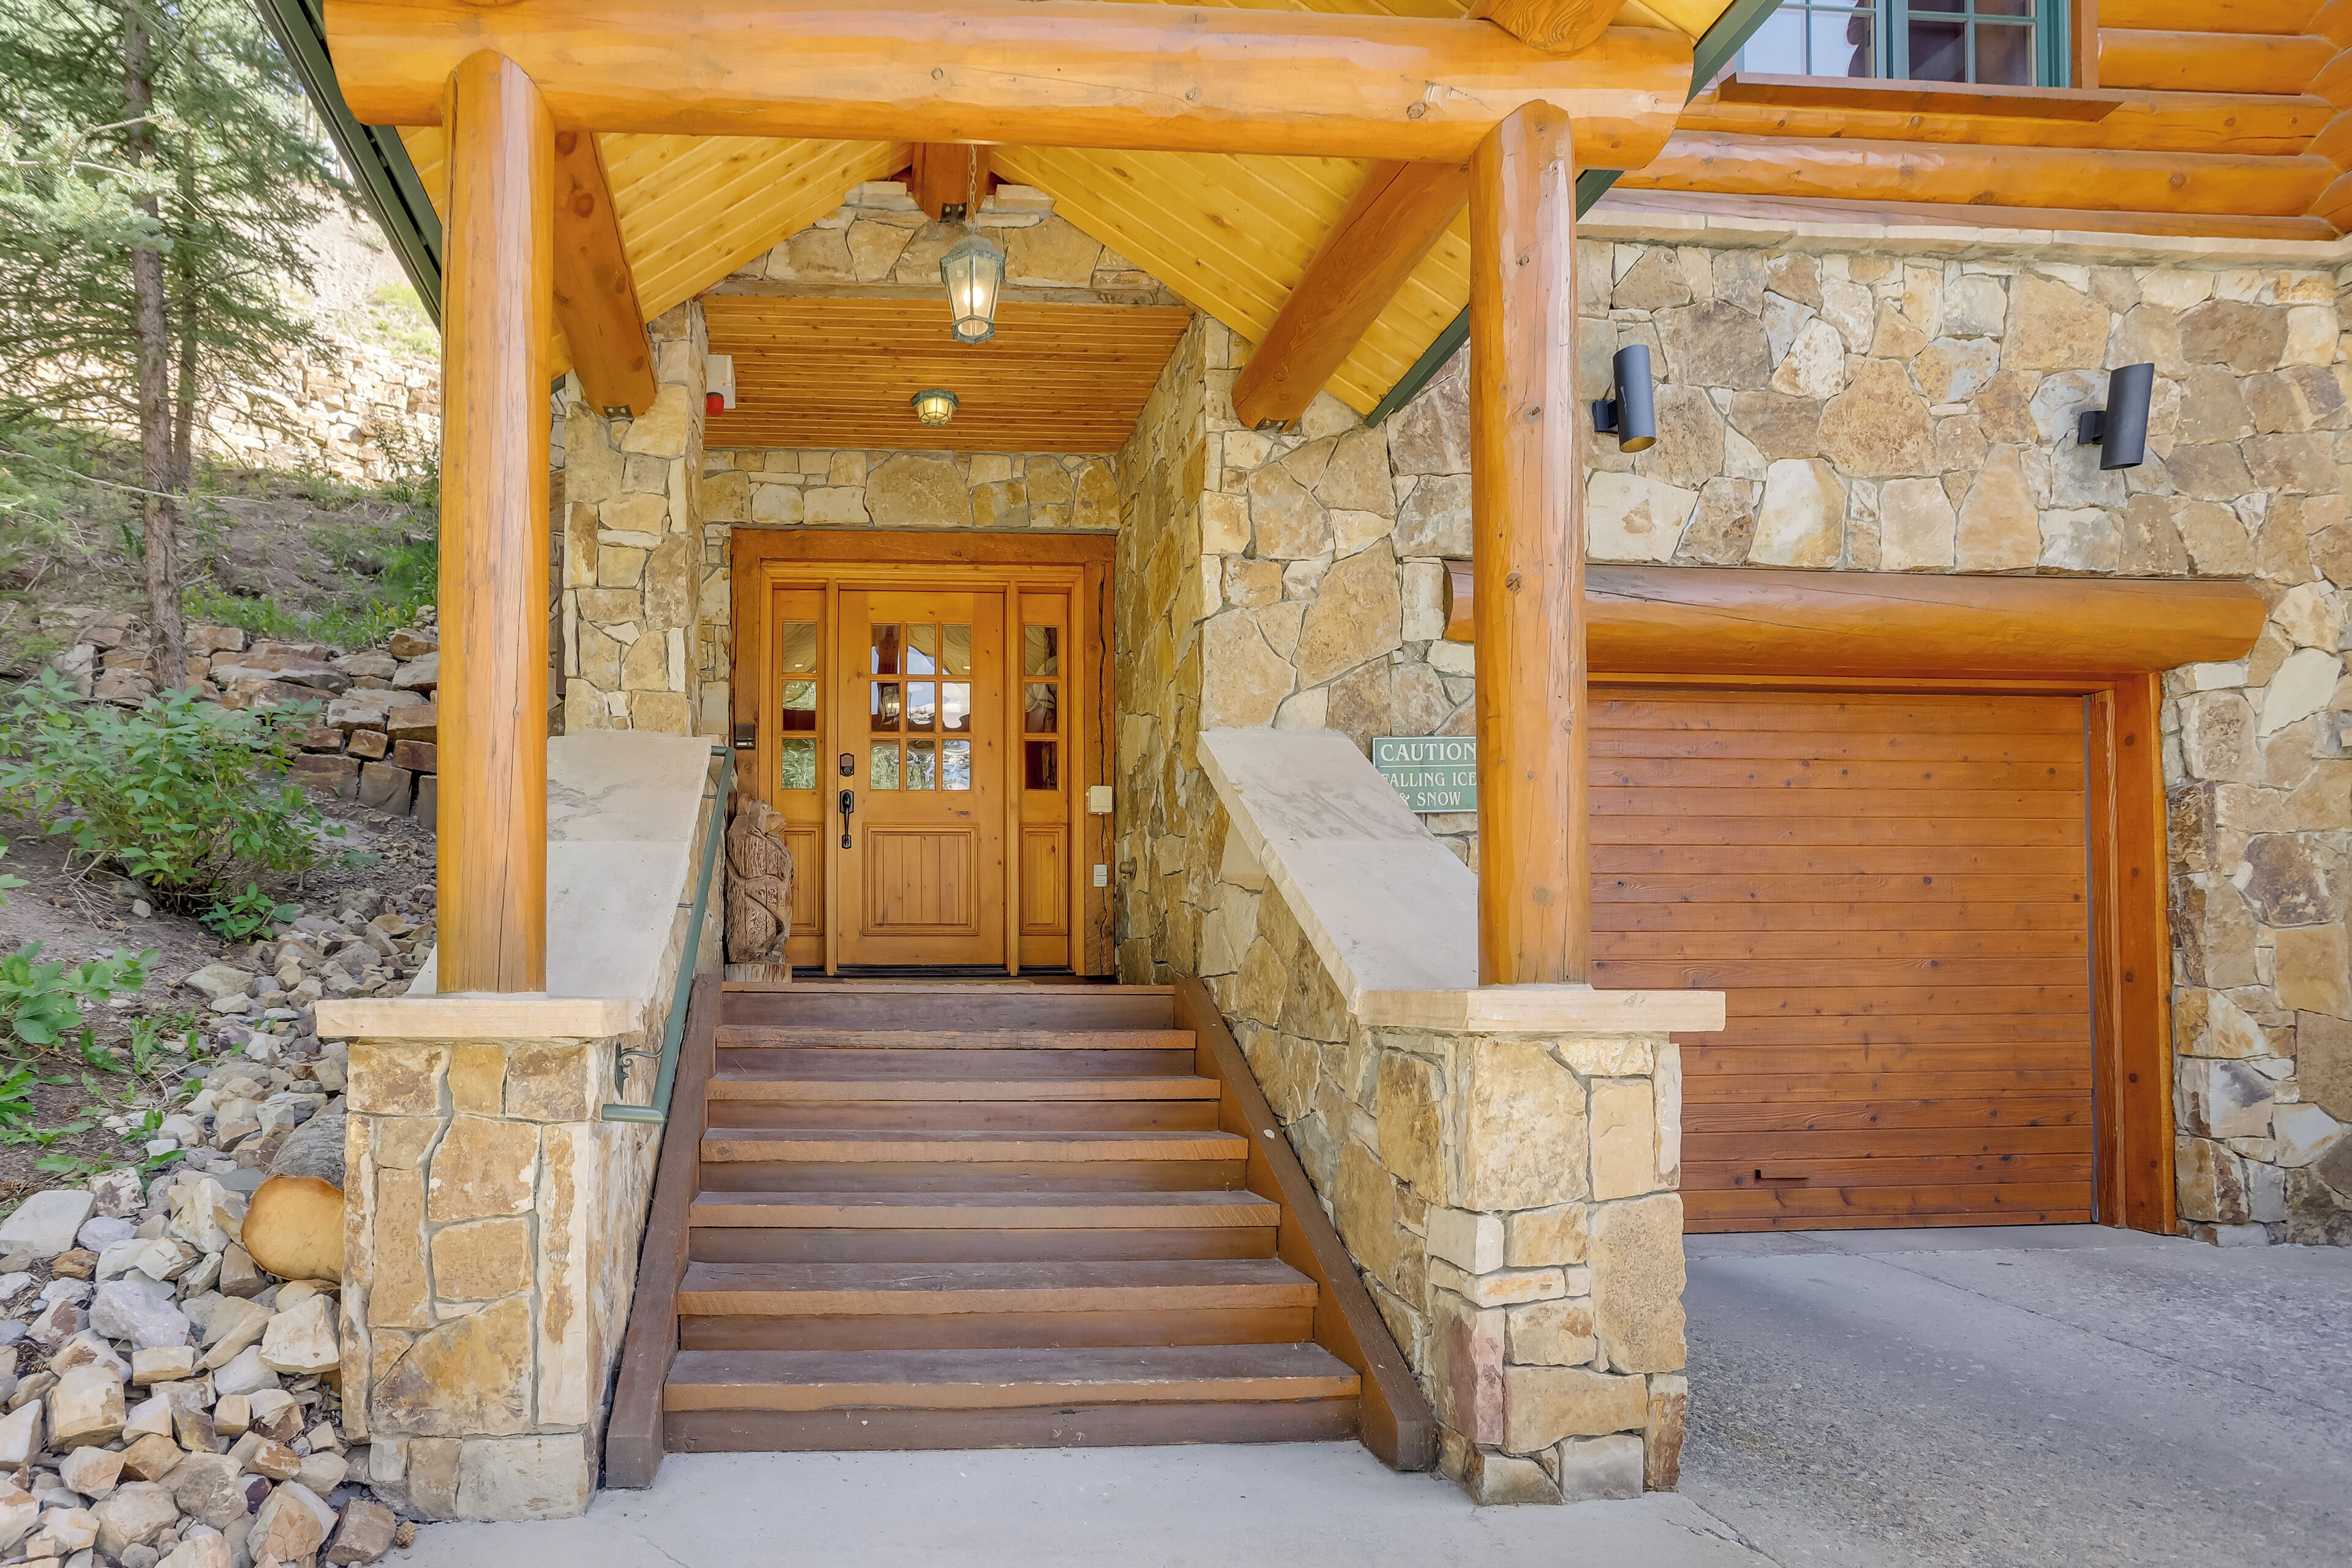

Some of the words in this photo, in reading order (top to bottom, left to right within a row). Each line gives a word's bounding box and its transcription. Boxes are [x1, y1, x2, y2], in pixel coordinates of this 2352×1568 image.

[1380, 743, 1476, 761] CAUTION
[1452, 772, 1476, 786] ICE
[1417, 791, 1461, 806] SNOW
